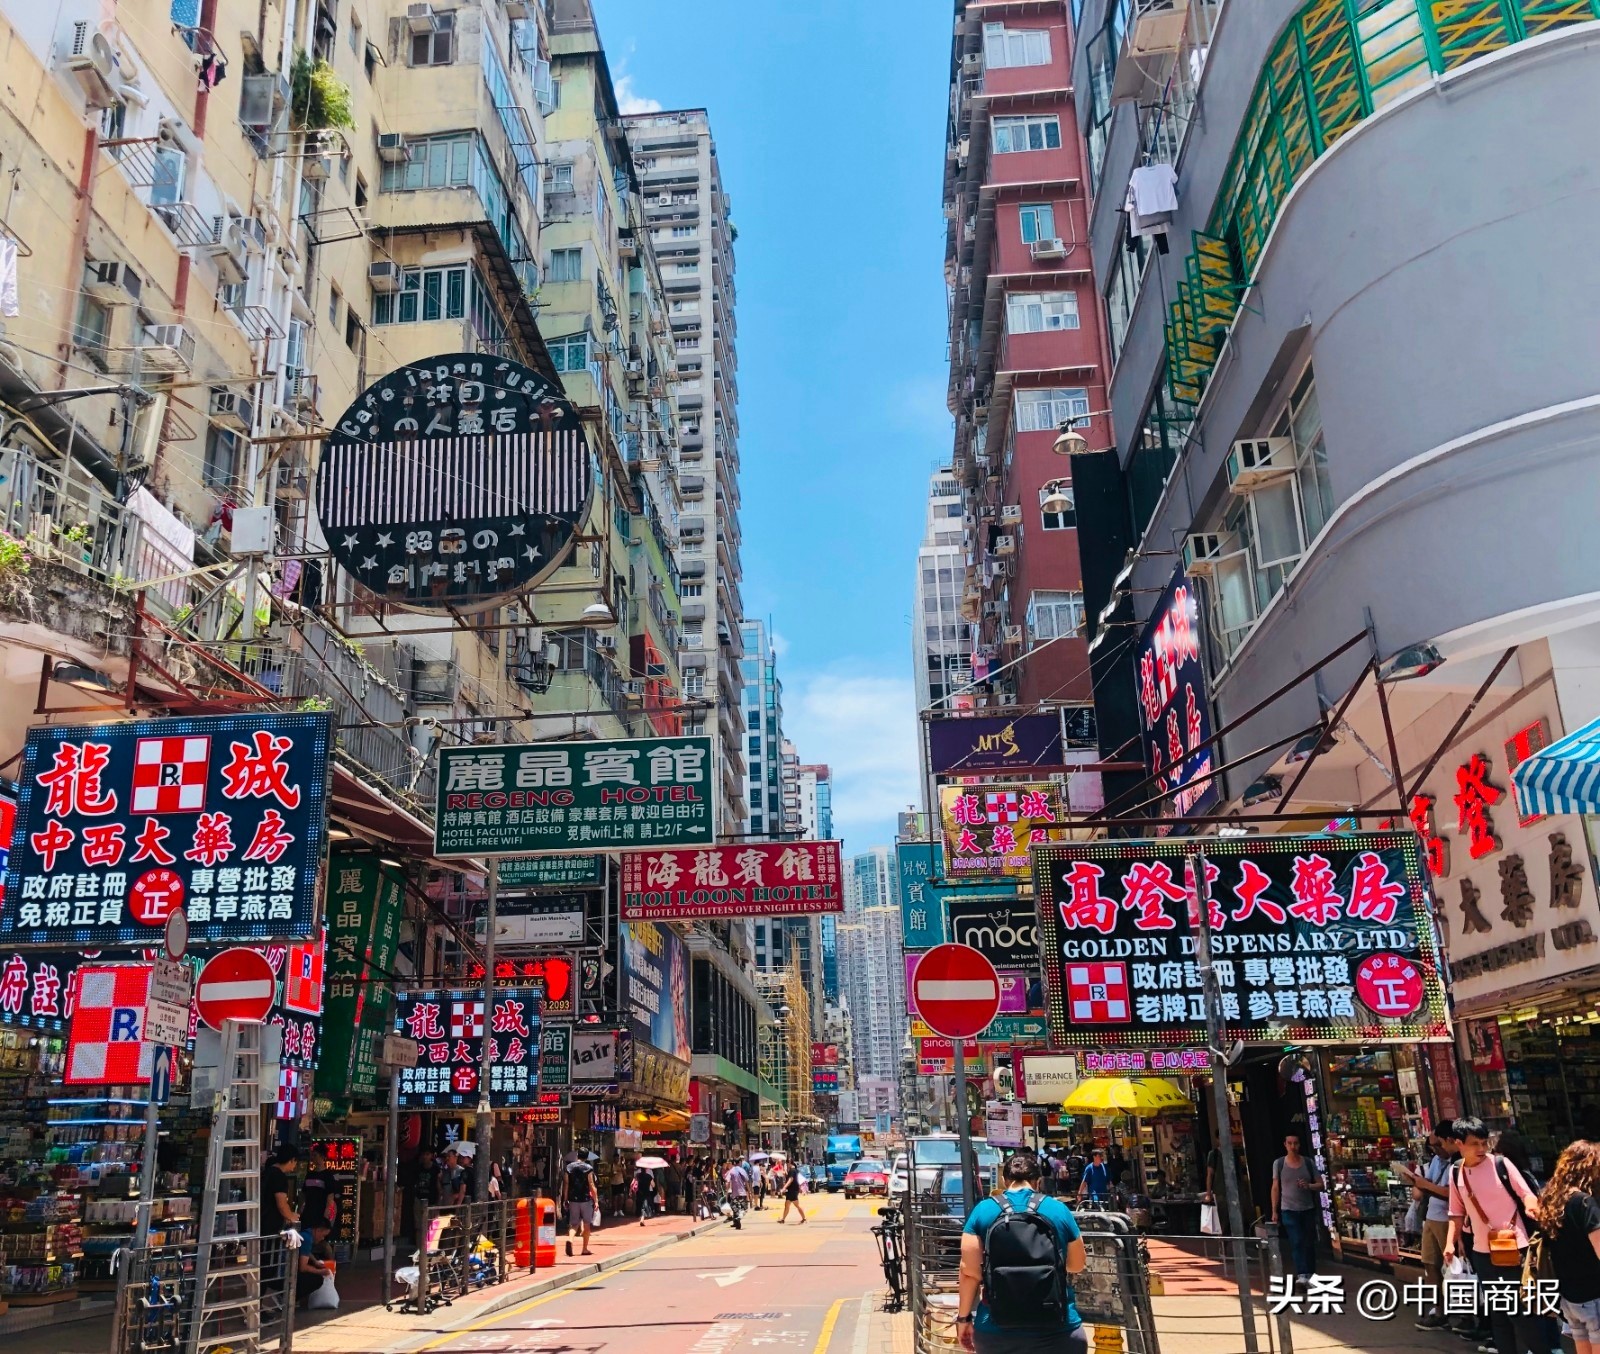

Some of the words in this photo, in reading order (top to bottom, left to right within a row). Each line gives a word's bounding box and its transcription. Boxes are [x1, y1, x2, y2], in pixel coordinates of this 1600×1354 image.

[36, 741, 118, 817] 龍
[221, 731, 301, 809] 城
[445, 744, 706, 792] 麗晶賓館
[447, 789, 575, 810] REGENG
[601, 785, 703, 805] HOTEL
[950, 794, 986, 825] 龍
[1021, 790, 1056, 823] 城
[443, 810, 501, 826] 持牌賓館
[505, 808, 565, 824] 酒店設備
[568, 805, 628, 822] 豪華套房
[631, 803, 706, 821] 歡迎自由行
[30, 809, 296, 871] 中西大藥房
[441, 838, 475, 848] HOTEL
[476, 837, 499, 847] FREE
[501, 836, 523, 845] WIFI
[442, 828, 474, 838] HOTEL
[476, 826, 519, 837] FACILITY
[520, 825, 562, 836] LIENSED
[640, 823, 683, 839] 請上2/F
[647, 847, 815, 890] 海龍賓館
[952, 857, 988, 869] DRAGON
[988, 856, 1008, 868] CITY
[21, 872, 127, 900] 政府註冊
[189, 865, 297, 893] 專營批發
[140, 892, 171, 919] 正
[624, 891, 673, 908] HOI
[677, 887, 747, 905] LOON
[752, 884, 838, 903] HOTEL
[17, 900, 124, 928] 免稅正貨
[187, 894, 294, 923] 蟲草燕窩
[645, 908, 679, 917] HOTEL
[735, 904, 762, 914] OVER
[763, 903, 796, 912] NIGHT
[797, 902, 823, 911] LESS
[1063, 936, 1167, 959] GOLDEN
[1181, 932, 1341, 956] DSPENSARY
[1357, 929, 1416, 950] LTD.
[1244, 956, 1351, 985] 專營批發
[1248, 990, 1355, 1021] 參茸燕窩
[1372, 978, 1411, 1010] 正
[406, 1002, 445, 1039] 龍
[492, 1000, 529, 1038] 城
[543, 1030, 566, 1053] 館
[479, 1065, 529, 1079] 營批發
[1086, 1052, 1146, 1070] 政府註冊
[402, 1066, 451, 1081] 政府註冊
[457, 1076, 472, 1091] 正
[1042, 1072, 1073, 1080] FRANCE
[401, 1080, 451, 1094] 免稅正貨
[478, 1079, 528, 1093] 草燕窩
[325, 1161, 356, 1170] PALACE
